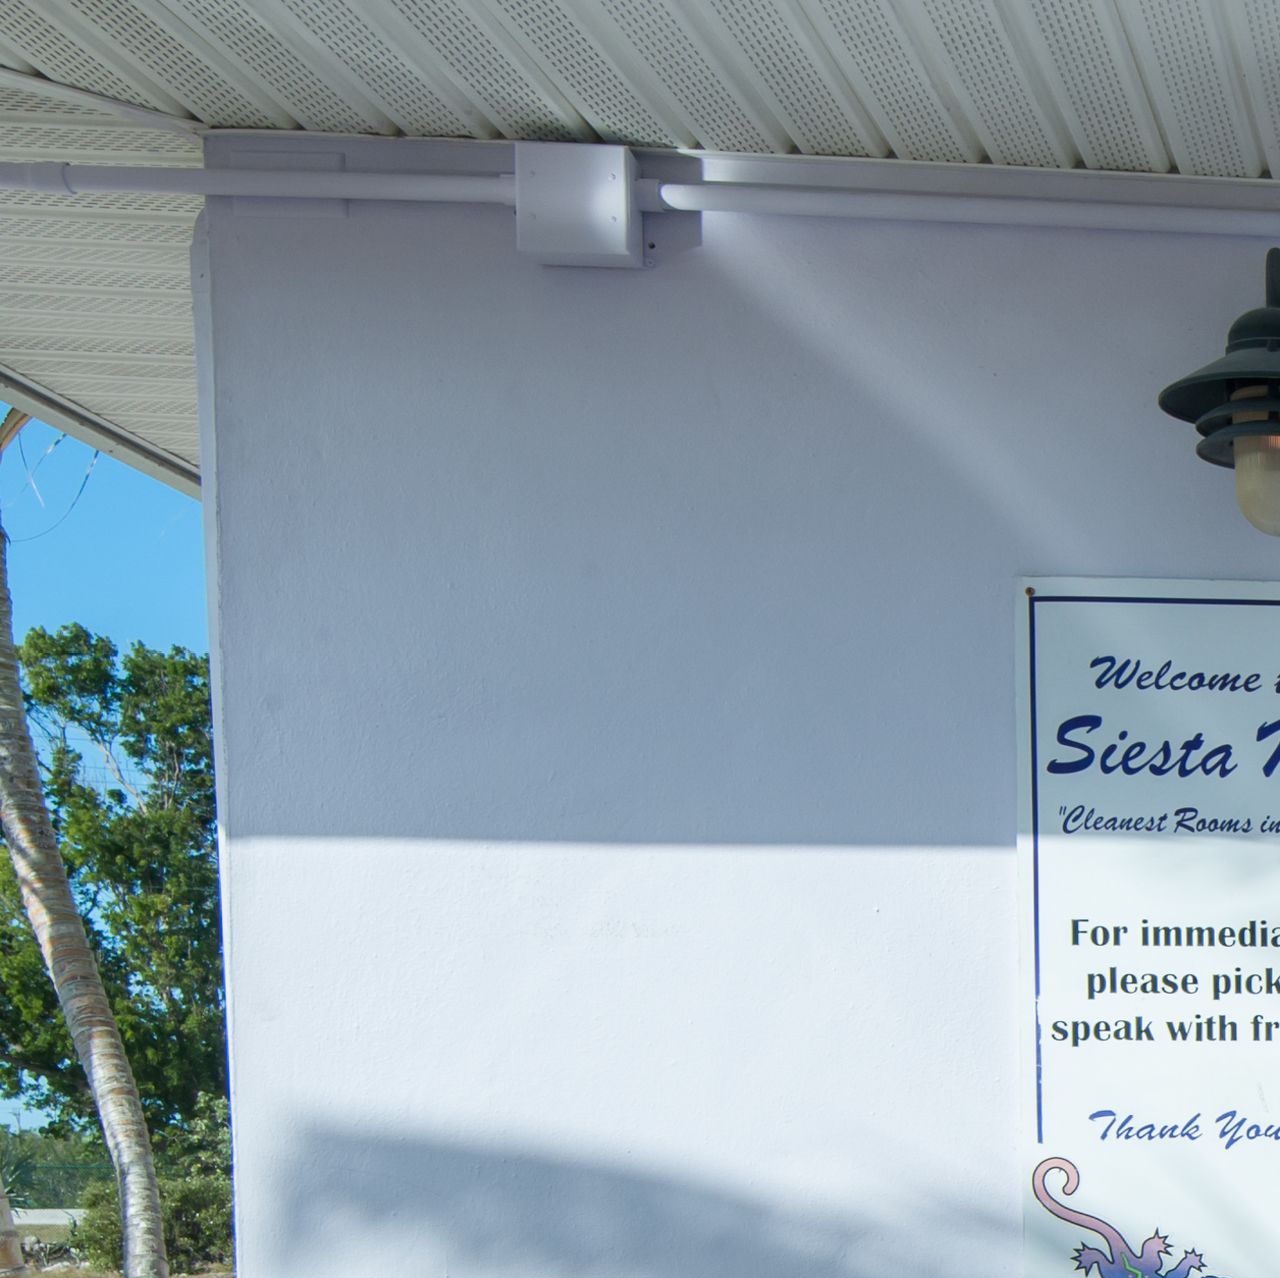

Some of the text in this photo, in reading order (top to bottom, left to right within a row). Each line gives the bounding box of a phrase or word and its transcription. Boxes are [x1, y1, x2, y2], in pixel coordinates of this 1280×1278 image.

[1089, 655, 1263, 694] Welcome
[1046, 714, 1238, 779] Siesta
[1058, 804, 1169, 834] "Cleanest
[1173, 806, 1253, 835] Rooms
[1070, 918, 1128, 949] For
[1086, 967, 1199, 1001] please
[1051, 1014, 1155, 1048] speak
[1166, 1014, 1240, 1042] with
[1088, 1109, 1204, 1142] Thank
